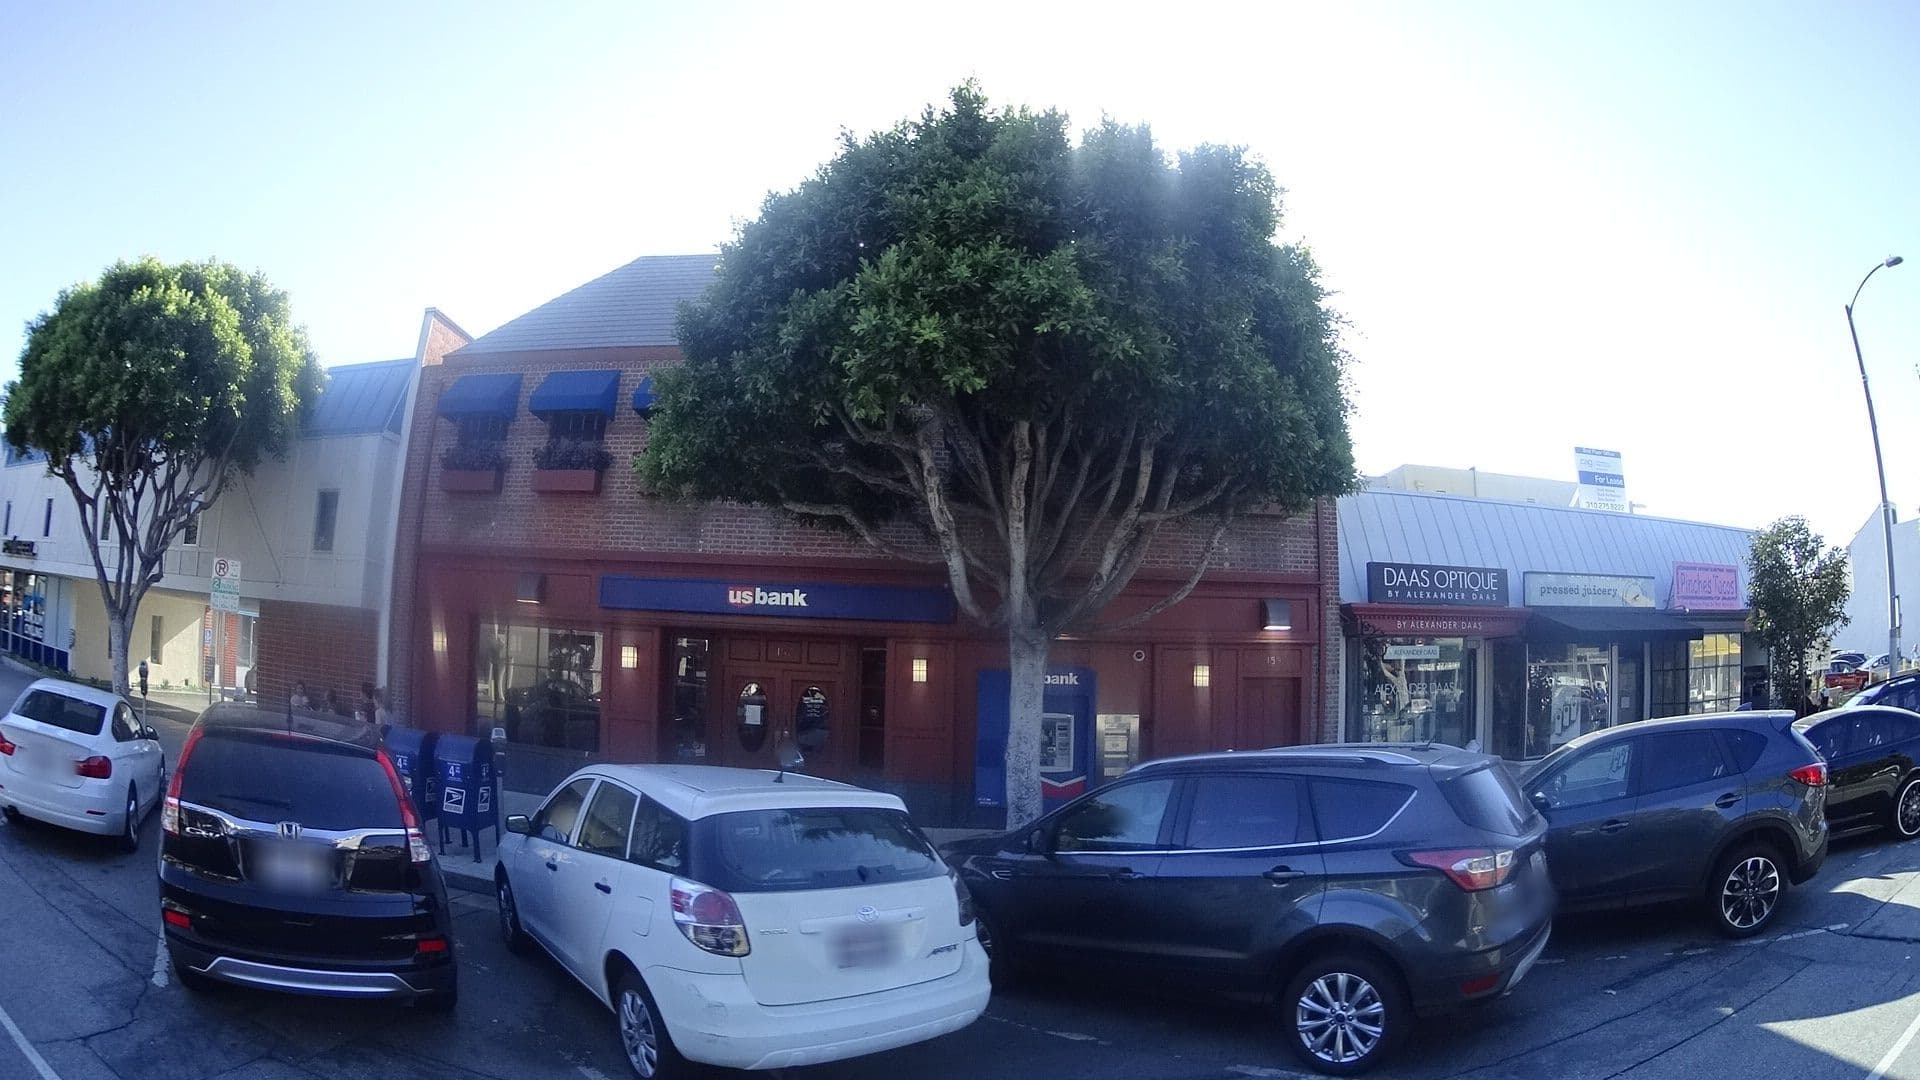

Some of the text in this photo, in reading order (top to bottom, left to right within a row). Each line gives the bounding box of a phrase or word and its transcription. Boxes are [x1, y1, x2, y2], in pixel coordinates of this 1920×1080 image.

[1594, 474, 1605, 483] For
[1384, 567, 1498, 591] DAAS OPTIQUE
[1387, 590, 1497, 601] BY ALEXANDER DAAS
[1540, 585, 1618, 598] pressed juicery
[1397, 620, 1482, 631] BY ALEXANDER DAAS
[1375, 682, 1428, 696] ALEXDER
